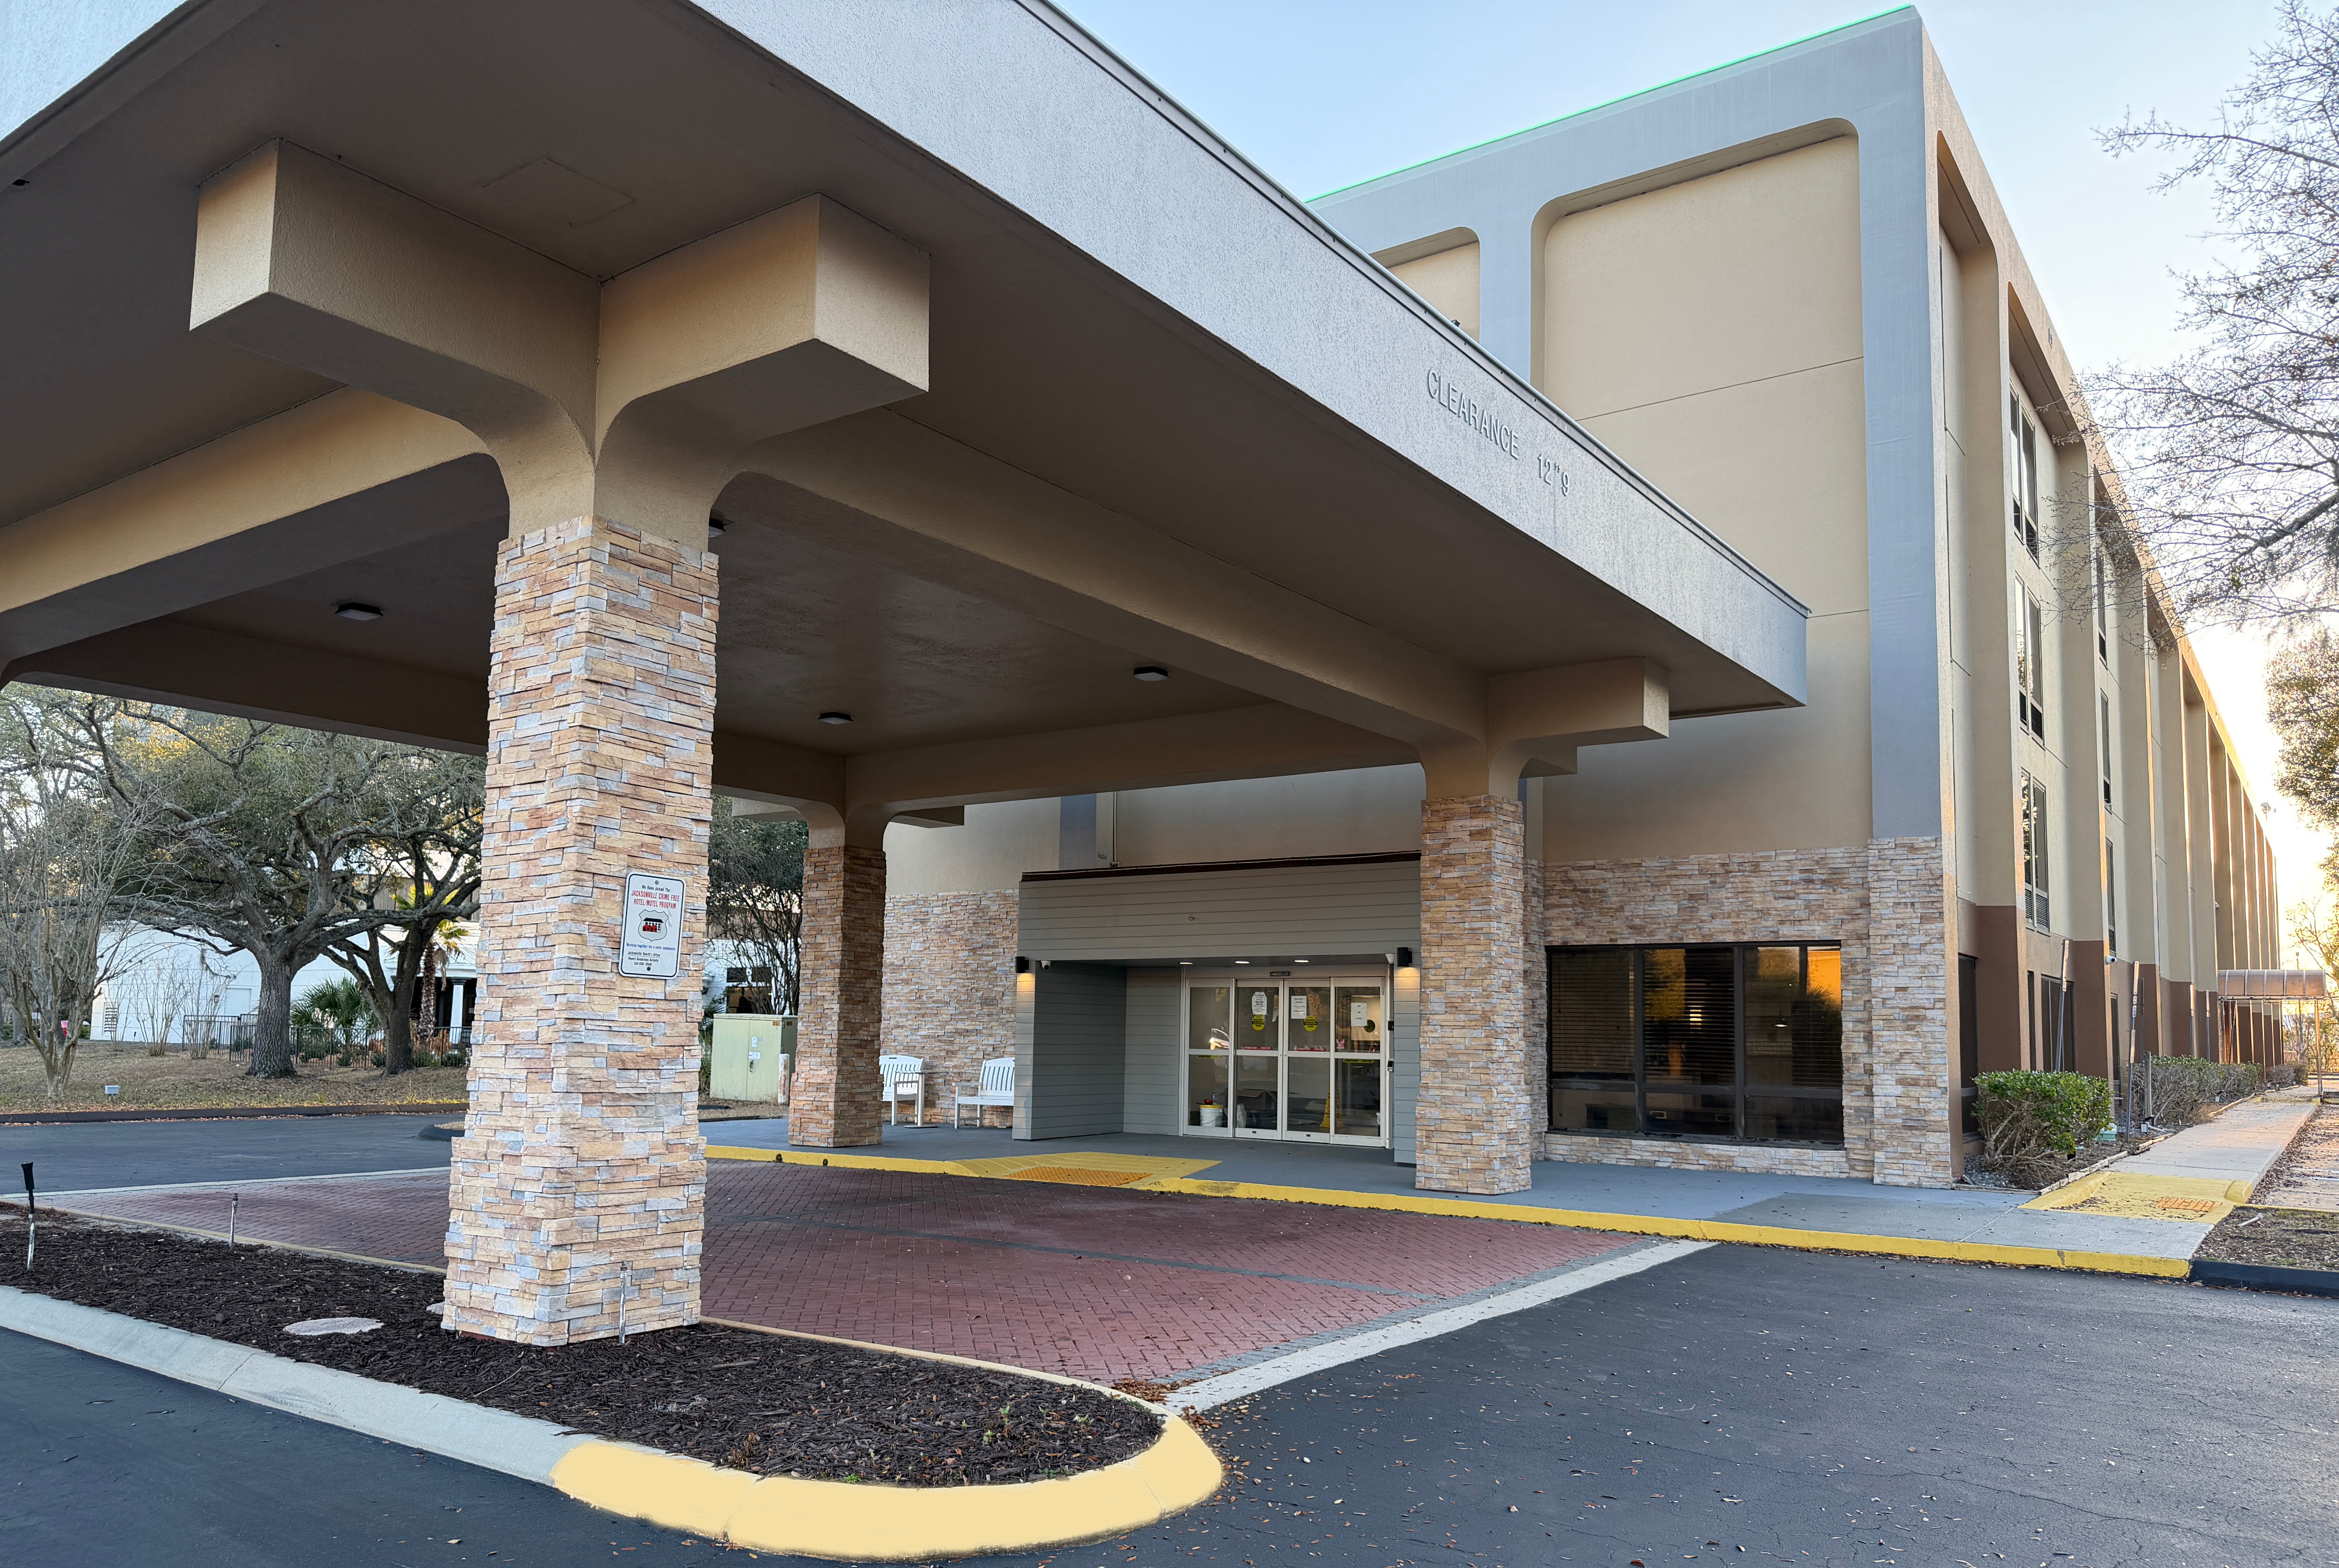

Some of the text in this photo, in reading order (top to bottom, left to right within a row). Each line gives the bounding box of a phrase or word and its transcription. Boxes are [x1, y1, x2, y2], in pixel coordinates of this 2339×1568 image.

[1427, 370, 1518, 459] CLEARANCE
[632, 890, 657, 899] JACKSONVILLE
[634, 898, 658, 907] HOTEL/MOTEL
